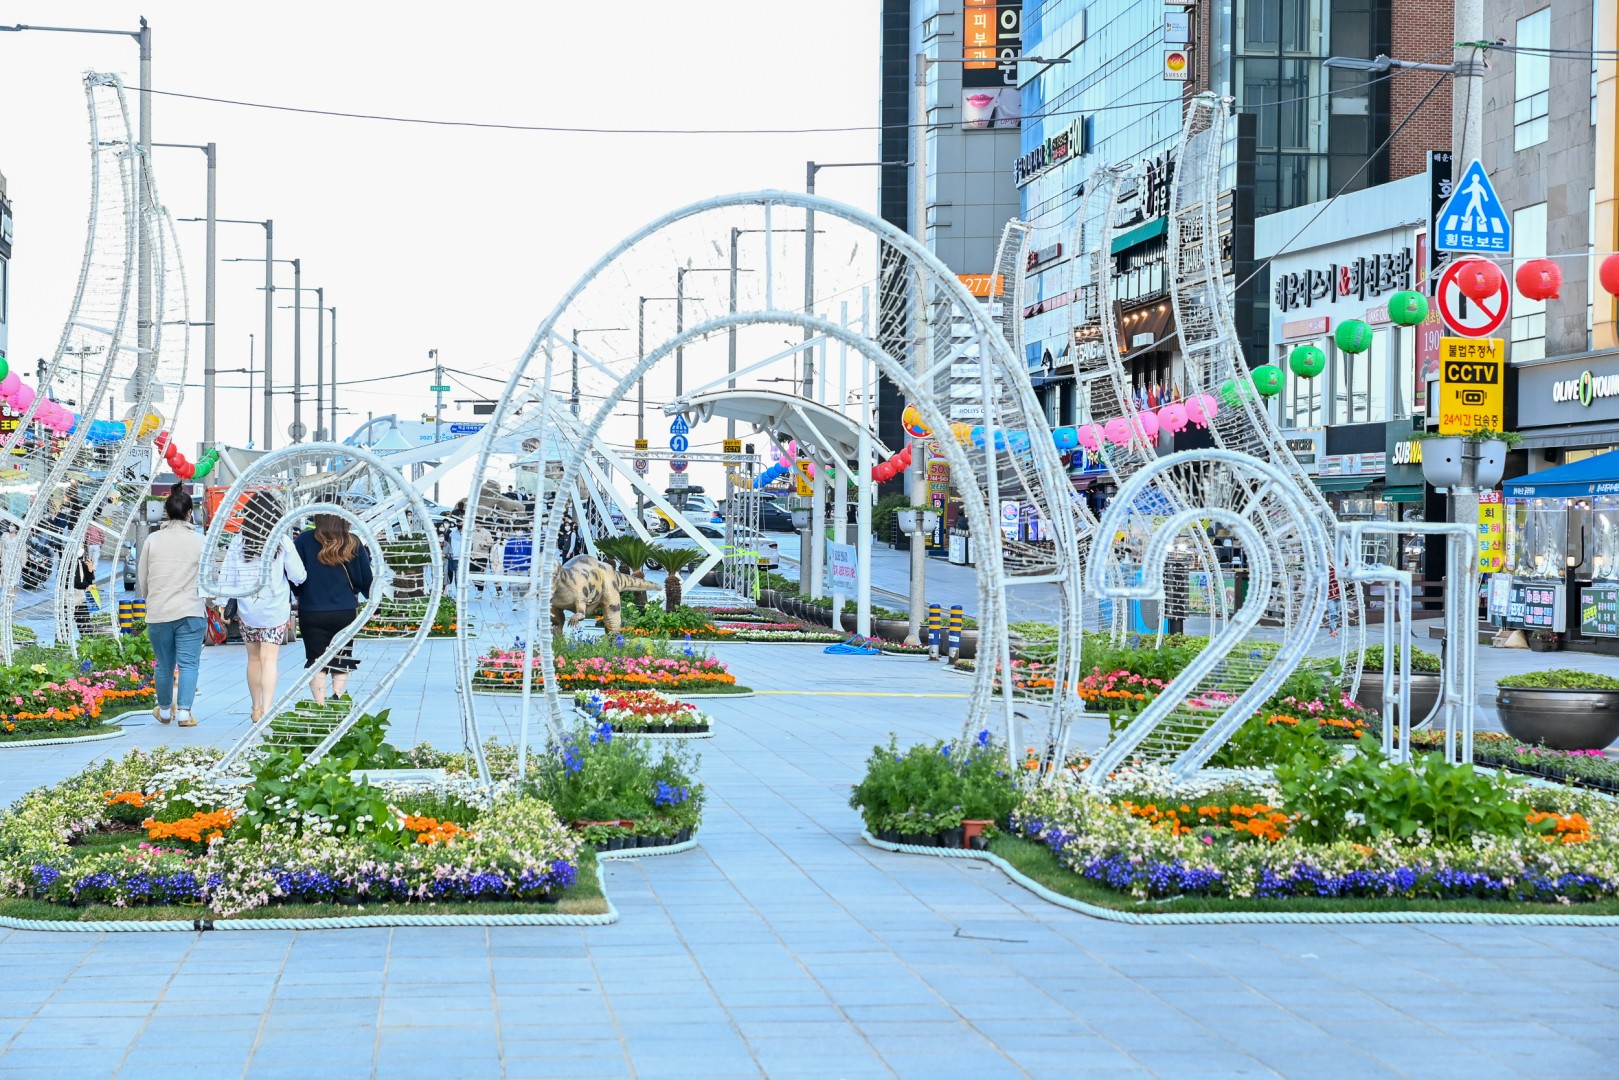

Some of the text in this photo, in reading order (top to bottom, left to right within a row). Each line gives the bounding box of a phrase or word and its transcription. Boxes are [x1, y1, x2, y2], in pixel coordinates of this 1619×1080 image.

[1445, 233, 1505, 249] 횡단보도
[1449, 345, 1496, 358] 불법주정차
[1447, 364, 1494, 381] CCTV
[1553, 374, 1619, 402] OLIVE YOUN
[1444, 414, 1498, 427] 24시간 단속중
[1392, 441, 1422, 465] SUBWA
[1479, 492, 1499, 503] 포장
[1485, 508, 1494, 518] 회
[1479, 523, 1489, 567] 꼼장어
